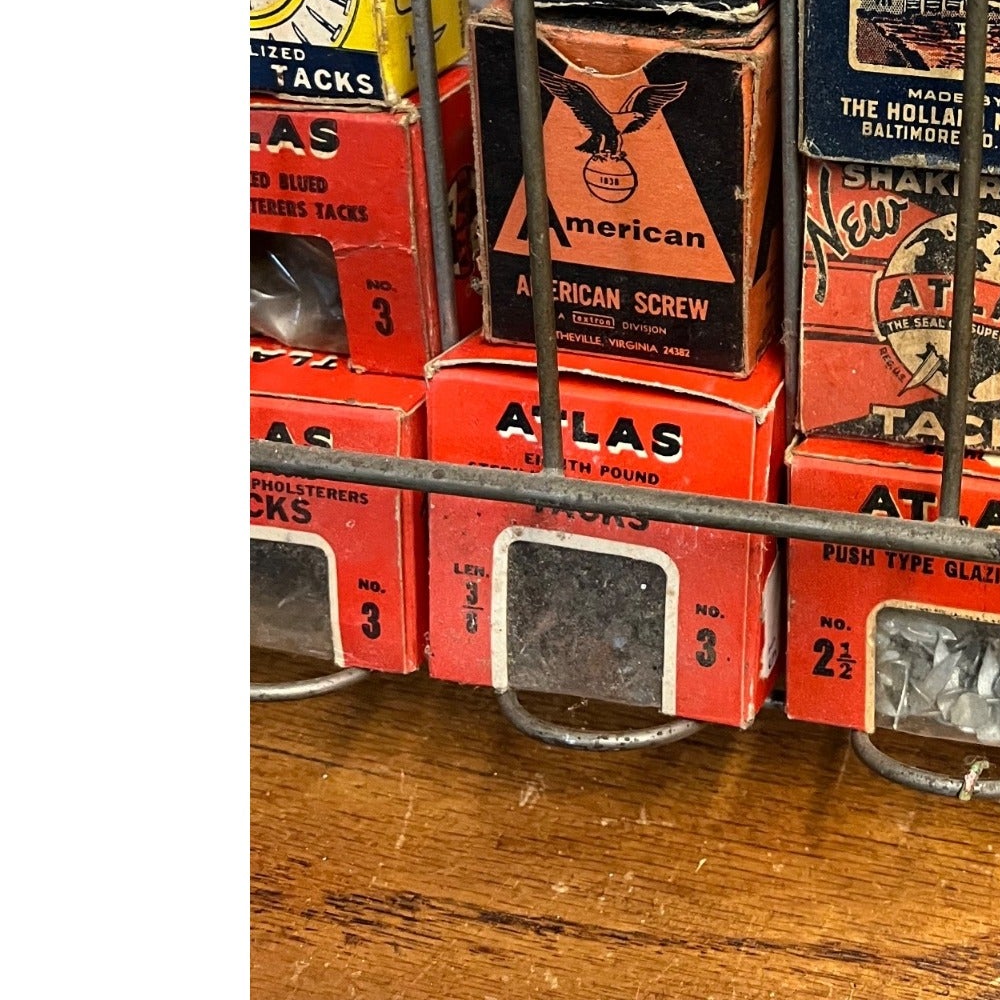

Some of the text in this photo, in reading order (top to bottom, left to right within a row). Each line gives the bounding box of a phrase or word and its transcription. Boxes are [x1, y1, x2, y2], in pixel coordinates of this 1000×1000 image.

[271, 64, 374, 94] TACKS
[908, 88, 963, 103] MADE
[841, 96, 878, 120] THE
[862, 121, 960, 145] BALTIMORE
[279, 173, 328, 194] BLUED
[315, 202, 368, 222] TACKS
[805, 162, 909, 303] New
[366, 278, 396, 293] NO.
[516, 274, 709, 321] AERICAN SCREW
[372, 297, 395, 337] 3
[887, 317, 909, 331] THE
[914, 316, 944, 329] SEAL
[622, 321, 667, 335] DIVISION
[609, 338, 658, 354] VIRGINIA
[663, 345, 690, 358] 24382
[600, 464, 660, 485] POUND
[823, 542, 875, 566] PUSH
[885, 550, 934, 575] TYPE
[453, 562, 490, 579] LEN.
[358, 577, 387, 594] NO.
[361, 601, 382, 639] 3
[695, 603, 724, 619] NO.
[820, 616, 852, 631] NO.
[695, 627, 717, 668] 3
